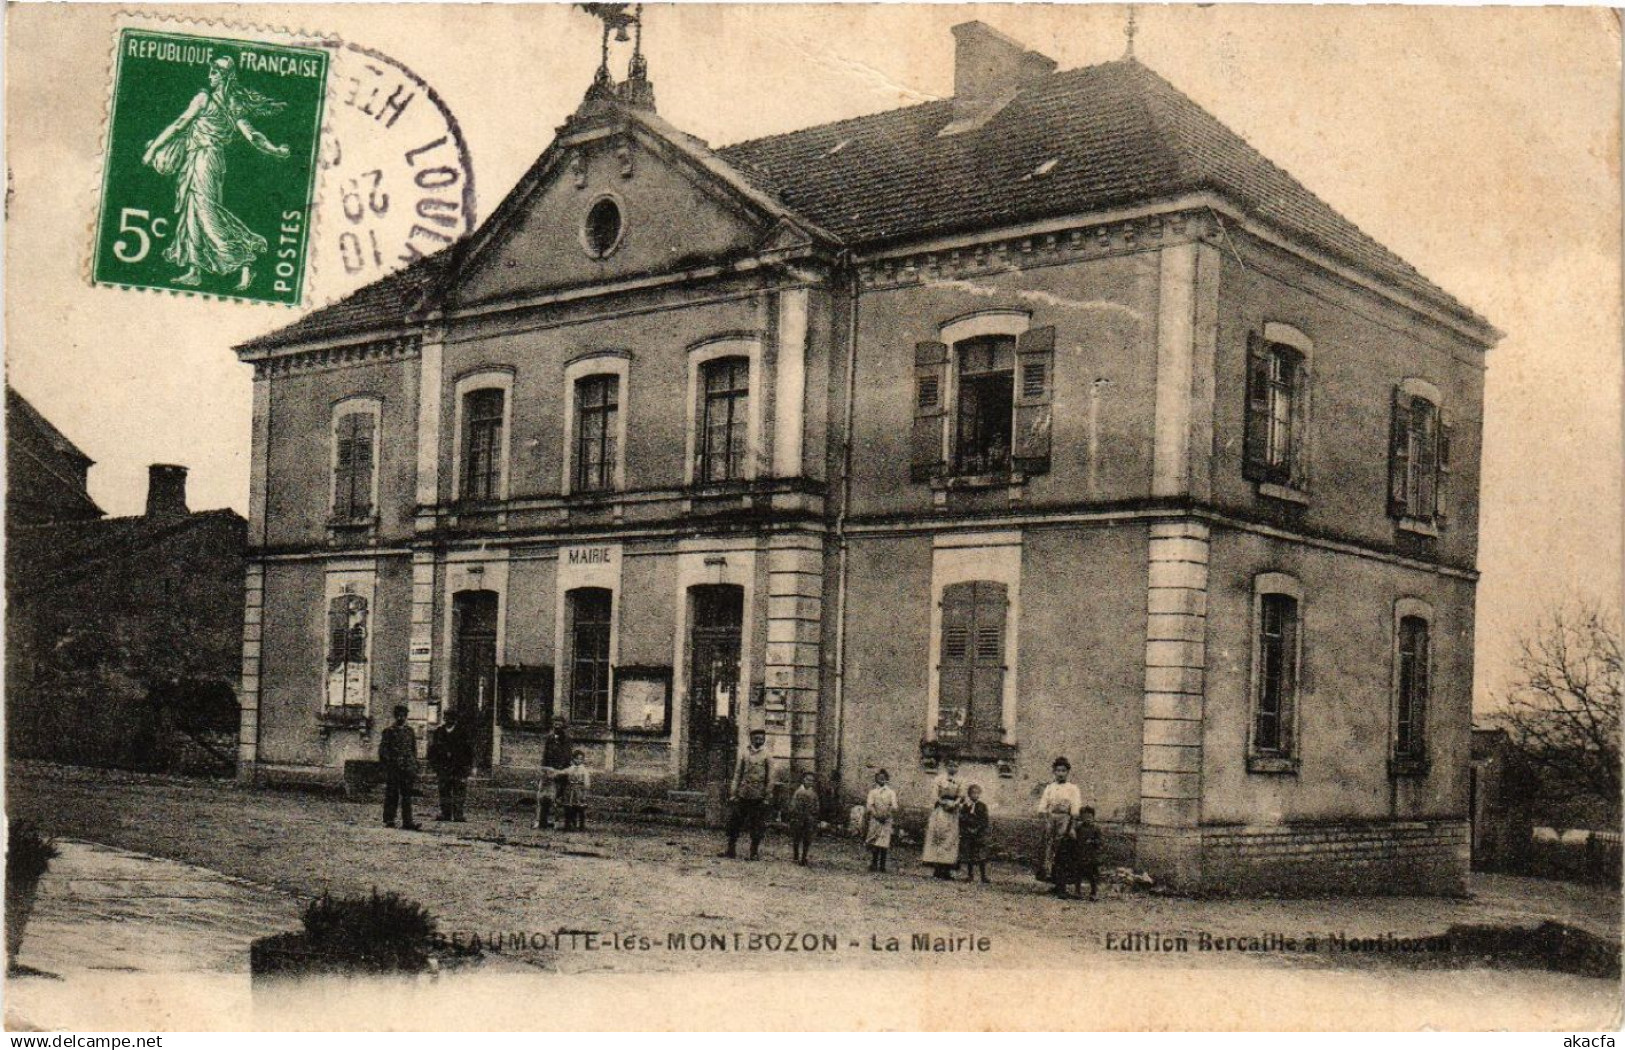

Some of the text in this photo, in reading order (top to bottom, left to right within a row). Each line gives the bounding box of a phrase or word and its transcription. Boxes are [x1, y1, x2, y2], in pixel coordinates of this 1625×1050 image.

[239, 51, 319, 79] FRANÇAISE
[273, 209, 301, 292] POSTES
[569, 547, 611, 565] MAIRIE
